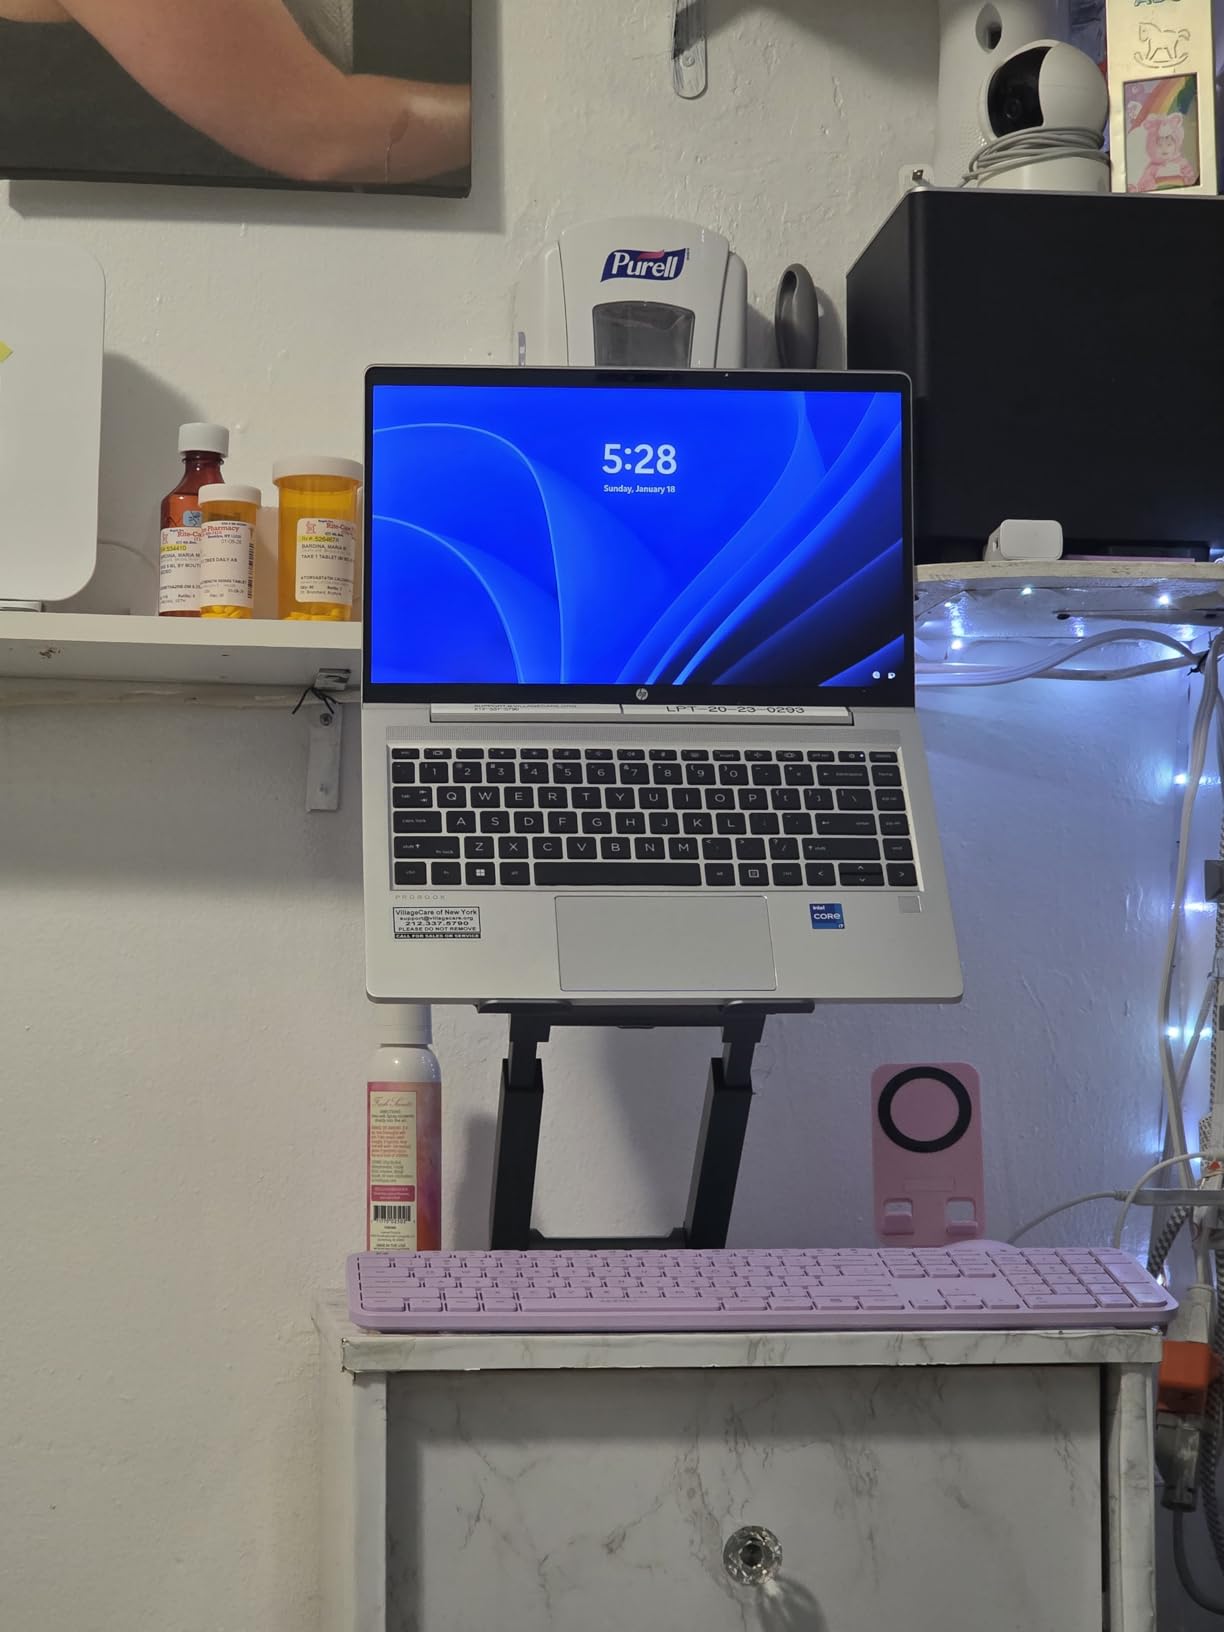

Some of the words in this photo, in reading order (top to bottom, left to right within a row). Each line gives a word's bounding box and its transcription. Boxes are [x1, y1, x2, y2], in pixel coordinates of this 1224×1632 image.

[611, 252, 679, 278] Purell
[602, 443, 677, 475] 5:28
[603, 484, 634, 494] Sunday,
[635, 485, 665, 495] January
[666, 485, 676, 493] 18
[447, 792, 456, 800] Q
[479, 792, 492, 800] W
[515, 792, 522, 800] E
[549, 792, 557, 800] R
[715, 794, 725, 802] O
[749, 794, 757, 802] P
[457, 817, 465, 825] A
[491, 817, 499, 825] S
[524, 817, 534, 825] D
[559, 817, 566, 825] F
[592, 818, 602, 826] G
[662, 818, 668, 826] J
[476, 843, 483, 851] Z
[510, 843, 518, 851] X
[543, 843, 552, 851] C
[577, 843, 586, 851] V
[611, 843, 620, 851] B
[813, 912, 841, 920] CORE
